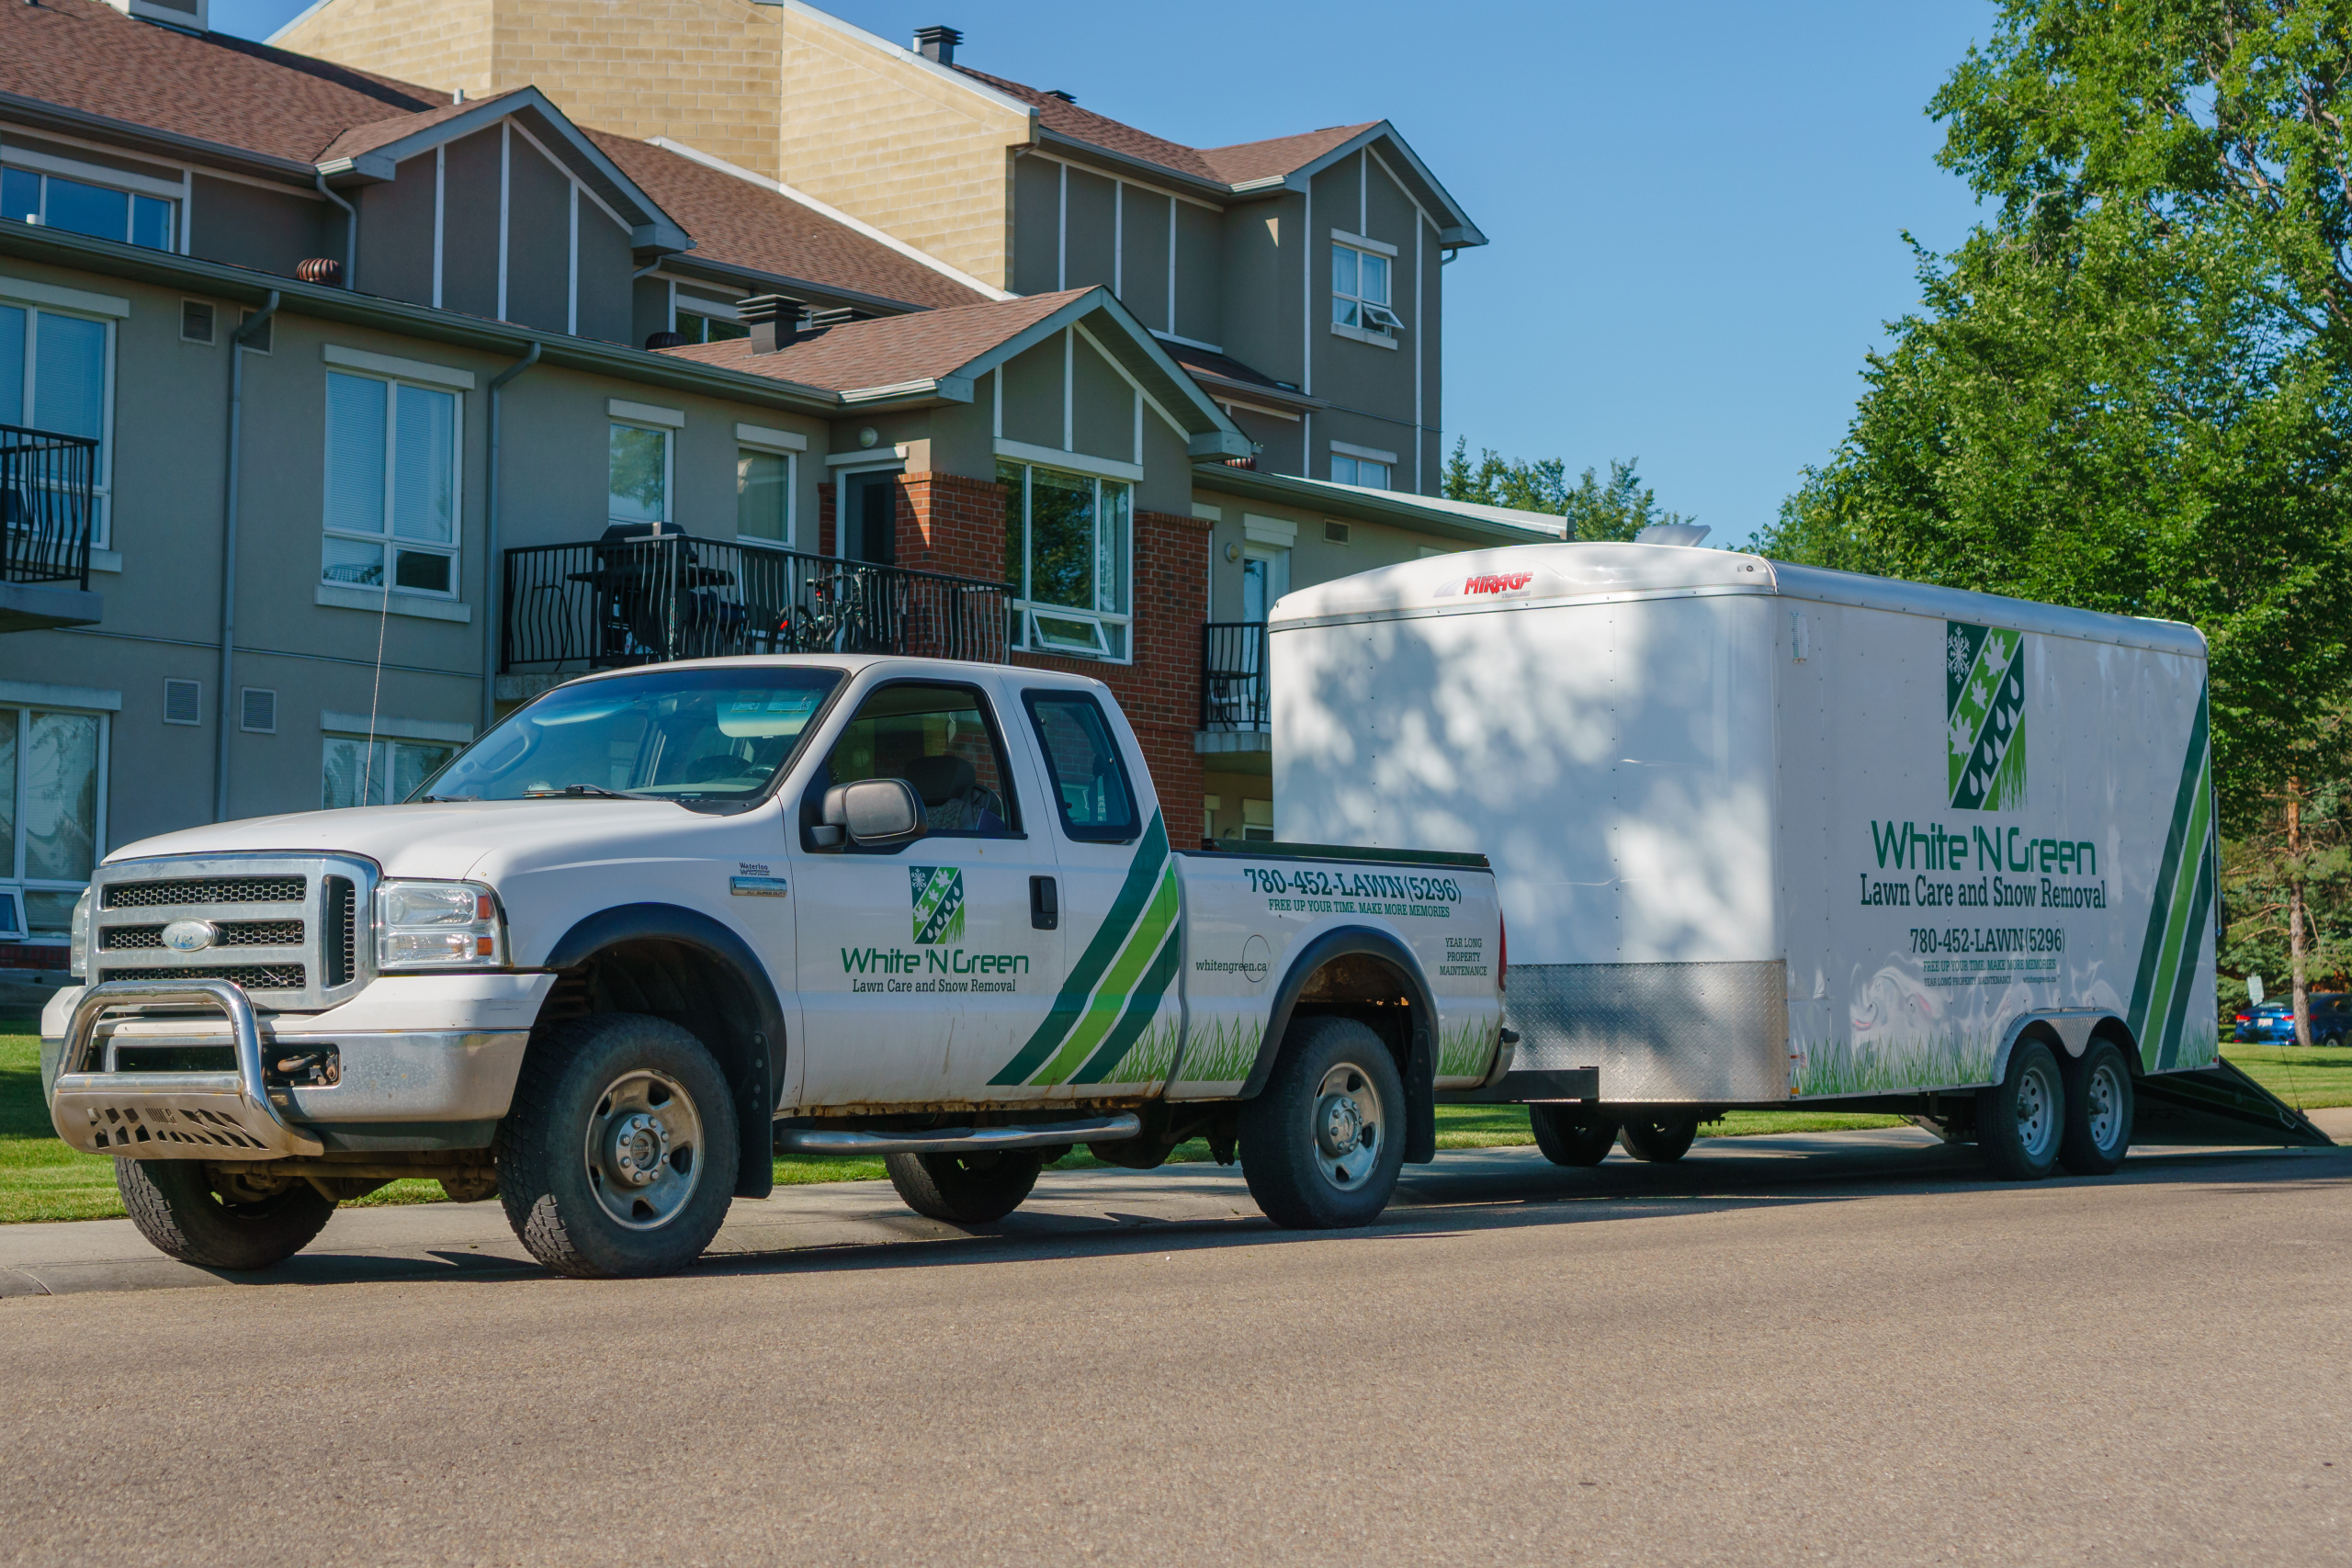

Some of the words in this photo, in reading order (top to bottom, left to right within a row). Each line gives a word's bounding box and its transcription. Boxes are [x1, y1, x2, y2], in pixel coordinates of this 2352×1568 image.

[1871, 819, 1969, 871] White
[2007, 827, 2097, 875] Green
[739, 862, 769, 871] Waterloo
[1243, 868, 1462, 904] 780-452-LAWN(5296)
[1860, 873, 1911, 906] Lawn
[1915, 874, 1954, 907] Care
[1958, 875, 1989, 907] and
[1993, 875, 2037, 908] Snow
[2041, 877, 2107, 908] Removal
[1269, 898, 1292, 911] FREE
[1294, 899, 1306, 912] UP
[1307, 900, 1333, 913] YOUR
[1334, 901, 1358, 913] TIME.
[1359, 902, 1384, 915] MAKE
[1385, 904, 1408, 916] MORE
[1409, 905, 1451, 918] MEMORIES
[1445, 938, 1463, 948] YEAR
[1464, 938, 1483, 948] LONG
[1910, 928, 2065, 954] 780-452-LAWN(5296)
[841, 947, 921, 974] White
[953, 949, 1029, 975] Green
[1446, 952, 1481, 962] PROPERTY
[1195, 959, 1267, 973] whitengreen.ca
[1439, 965, 1487, 976] MAINTENANCE
[1923, 961, 1939, 972] FREE
[1940, 961, 1951, 972] UP
[1951, 960, 1969, 971] YOUR
[1987, 960, 2006, 971] MAKE
[2007, 959, 2025, 970] MORE
[2025, 959, 2056, 970] MEMORIES
[852, 979, 885, 993] Lawn
[888, 979, 912, 993] Care
[915, 979, 935, 993] and
[938, 979, 968, 993] Snow
[970, 979, 1016, 993] Removal
[1924, 977, 1937, 987] YEAR
[1938, 976, 1951, 987] LONG
[1952, 976, 1977, 986] PROPERTY
[1978, 976, 2012, 985] MAINTENANCE
[2022, 976, 2057, 985] whitengreen.ca
